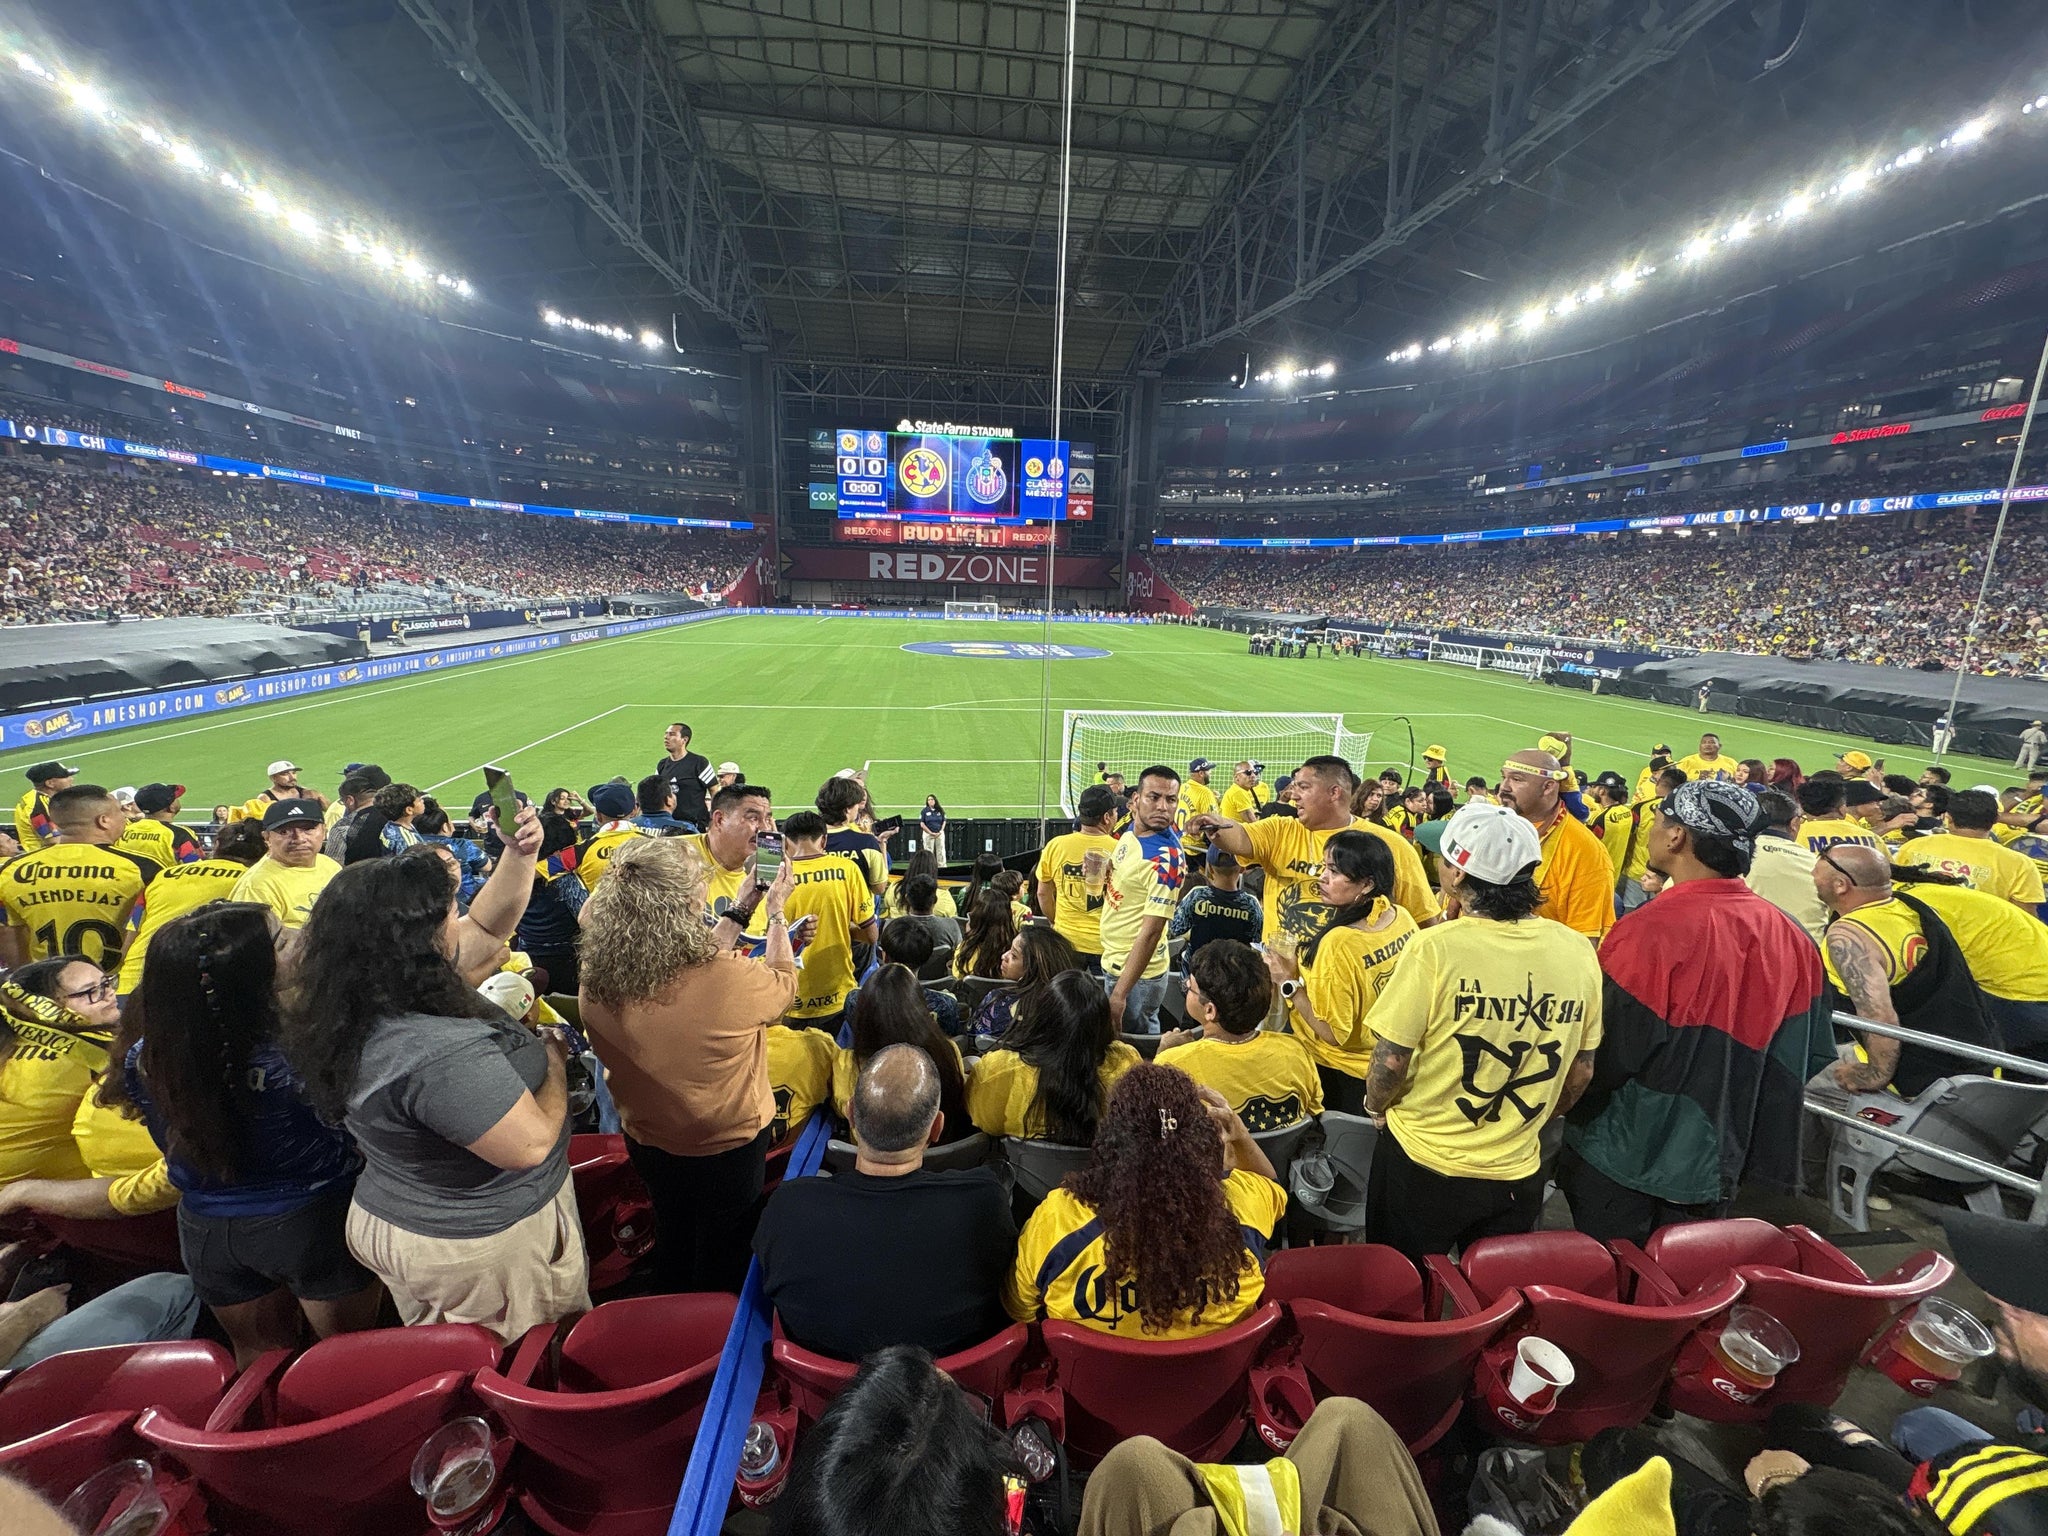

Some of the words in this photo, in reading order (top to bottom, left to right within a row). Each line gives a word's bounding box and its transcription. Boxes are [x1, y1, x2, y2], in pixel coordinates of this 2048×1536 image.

[24, 425, 36, 438] 0
[971, 426, 1014, 438] STADIUM
[79, 435, 106, 450] CHI
[843, 458, 857, 474] 0
[868, 460, 882, 475] 0
[849, 483, 876, 493] 0:00
[1025, 488, 1063, 498] MÉXICO
[811, 491, 836, 501] COX
[1883, 496, 1914, 511] CHI
[1749, 509, 1759, 520] 0
[1781, 505, 1808, 517] 0:00
[1830, 502, 1842, 514] 0
[1693, 514, 1717, 524] AME
[844, 526, 892, 537] REDZONE
[903, 525, 944, 542] BUD
[946, 526, 1001, 543] LIGHT
[868, 552, 1039, 584] REDZONE
[570, 630, 599, 643] GLENDALE
[367, 659, 420, 677] AMESHOP.COM
[258, 673, 331, 697] AMESHOP.COM
[228, 686, 245, 702] AME
[93, 694, 204, 727] AMESHOP.COM
[45, 713, 71, 733] AME
[121, 830, 161, 843] Corona
[13, 861, 117, 886] Corona
[163, 865, 244, 880] Coron
[793, 867, 847, 886] orona
[1194, 899, 1250, 921] Corona
[35, 919, 123, 975] 10
[1460, 979, 1483, 994] LA
[806, 992, 839, 1008] AT&T
[9, 1019, 77, 1055] MERICA
